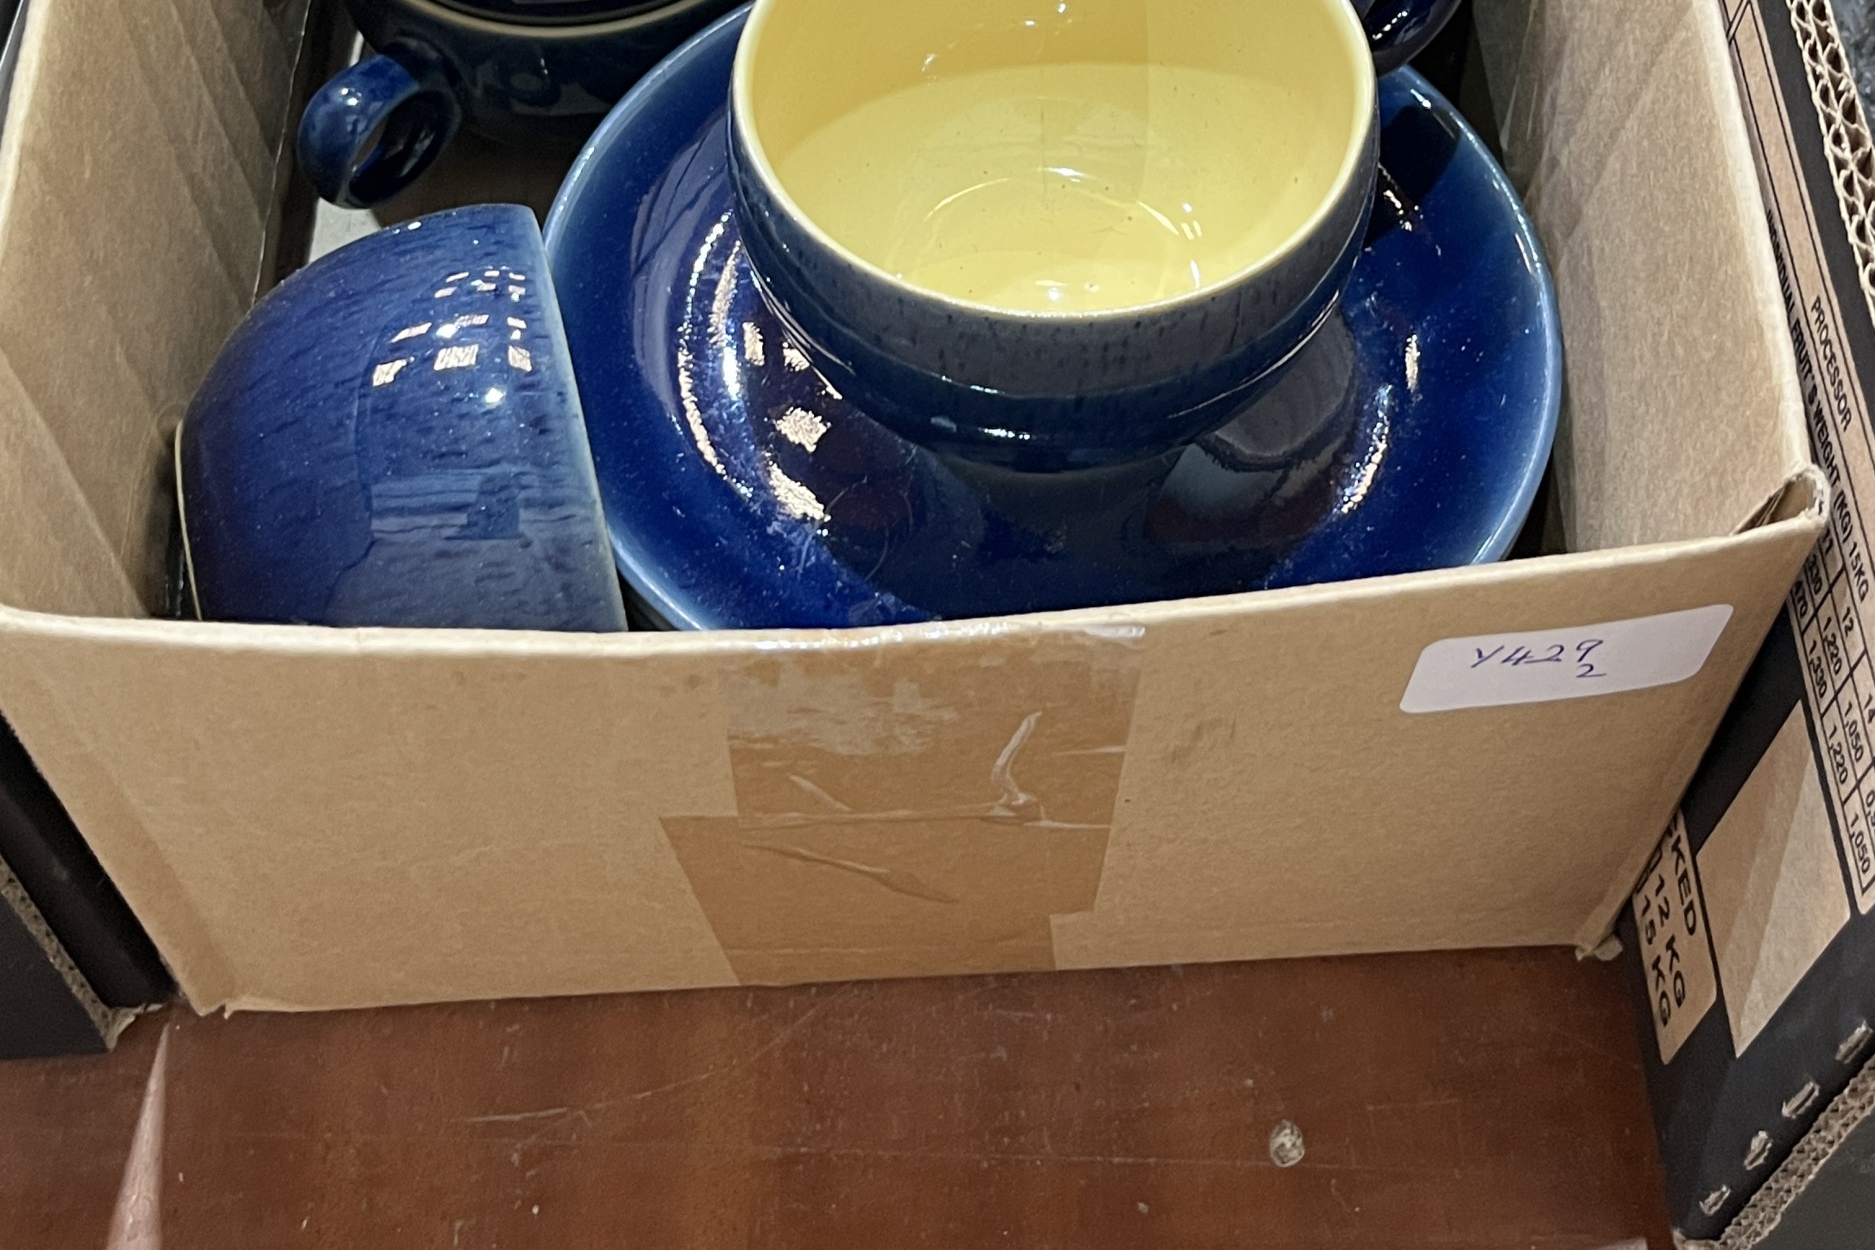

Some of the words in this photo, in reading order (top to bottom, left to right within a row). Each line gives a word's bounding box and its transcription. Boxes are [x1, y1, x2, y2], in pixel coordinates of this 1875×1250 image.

[1811, 295, 1852, 433] PROCESSOR
[1812, 401, 1840, 487] WEIGHT
[1833, 490, 1854, 543] (KG)
[1848, 542, 1869, 602] 15KG
[1822, 616, 1843, 676] 1,220
[1844, 700, 1864, 763] 1,050
[1842, 606, 1855, 637] 12
[1808, 639, 1828, 699] 1,330
[1828, 724, 1849, 785] 1,220
[1850, 812, 1871, 874] 1,050
[1641, 894, 1657, 946] 15
[1652, 954, 1671, 1028] KG
[1655, 873, 1671, 927] 12
[1665, 933, 1686, 1008] KG
